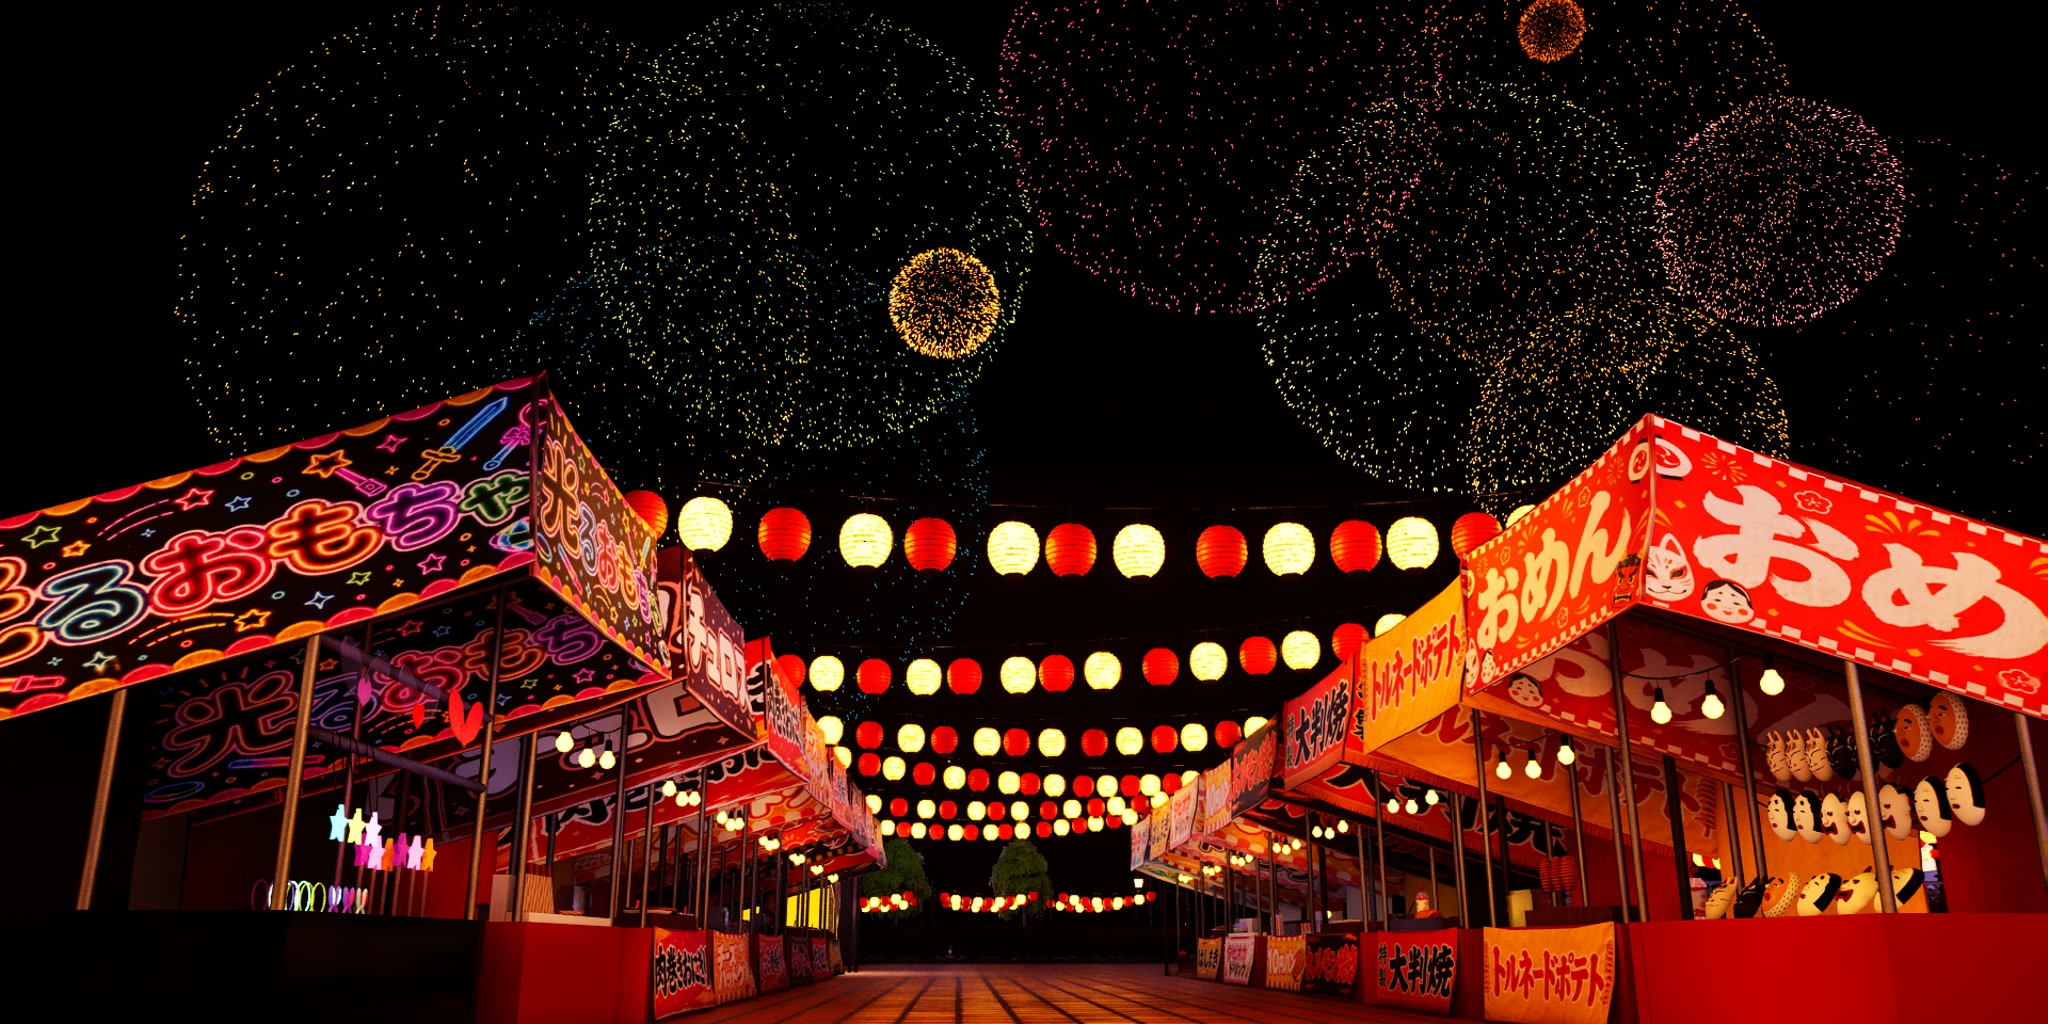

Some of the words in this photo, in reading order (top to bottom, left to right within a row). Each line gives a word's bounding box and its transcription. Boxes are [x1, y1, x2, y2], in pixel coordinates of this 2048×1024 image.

[1476, 489, 1632, 651] おめん
[1693, 484, 2048, 660] おめ
[1371, 612, 1461, 722] トルネードポテト
[1294, 680, 1349, 767] 大判焼
[656, 943, 711, 999] 肉巻きおにぎり
[1389, 943, 1455, 998] 大判焼
[1492, 944, 1605, 1008] トルネードポテト
